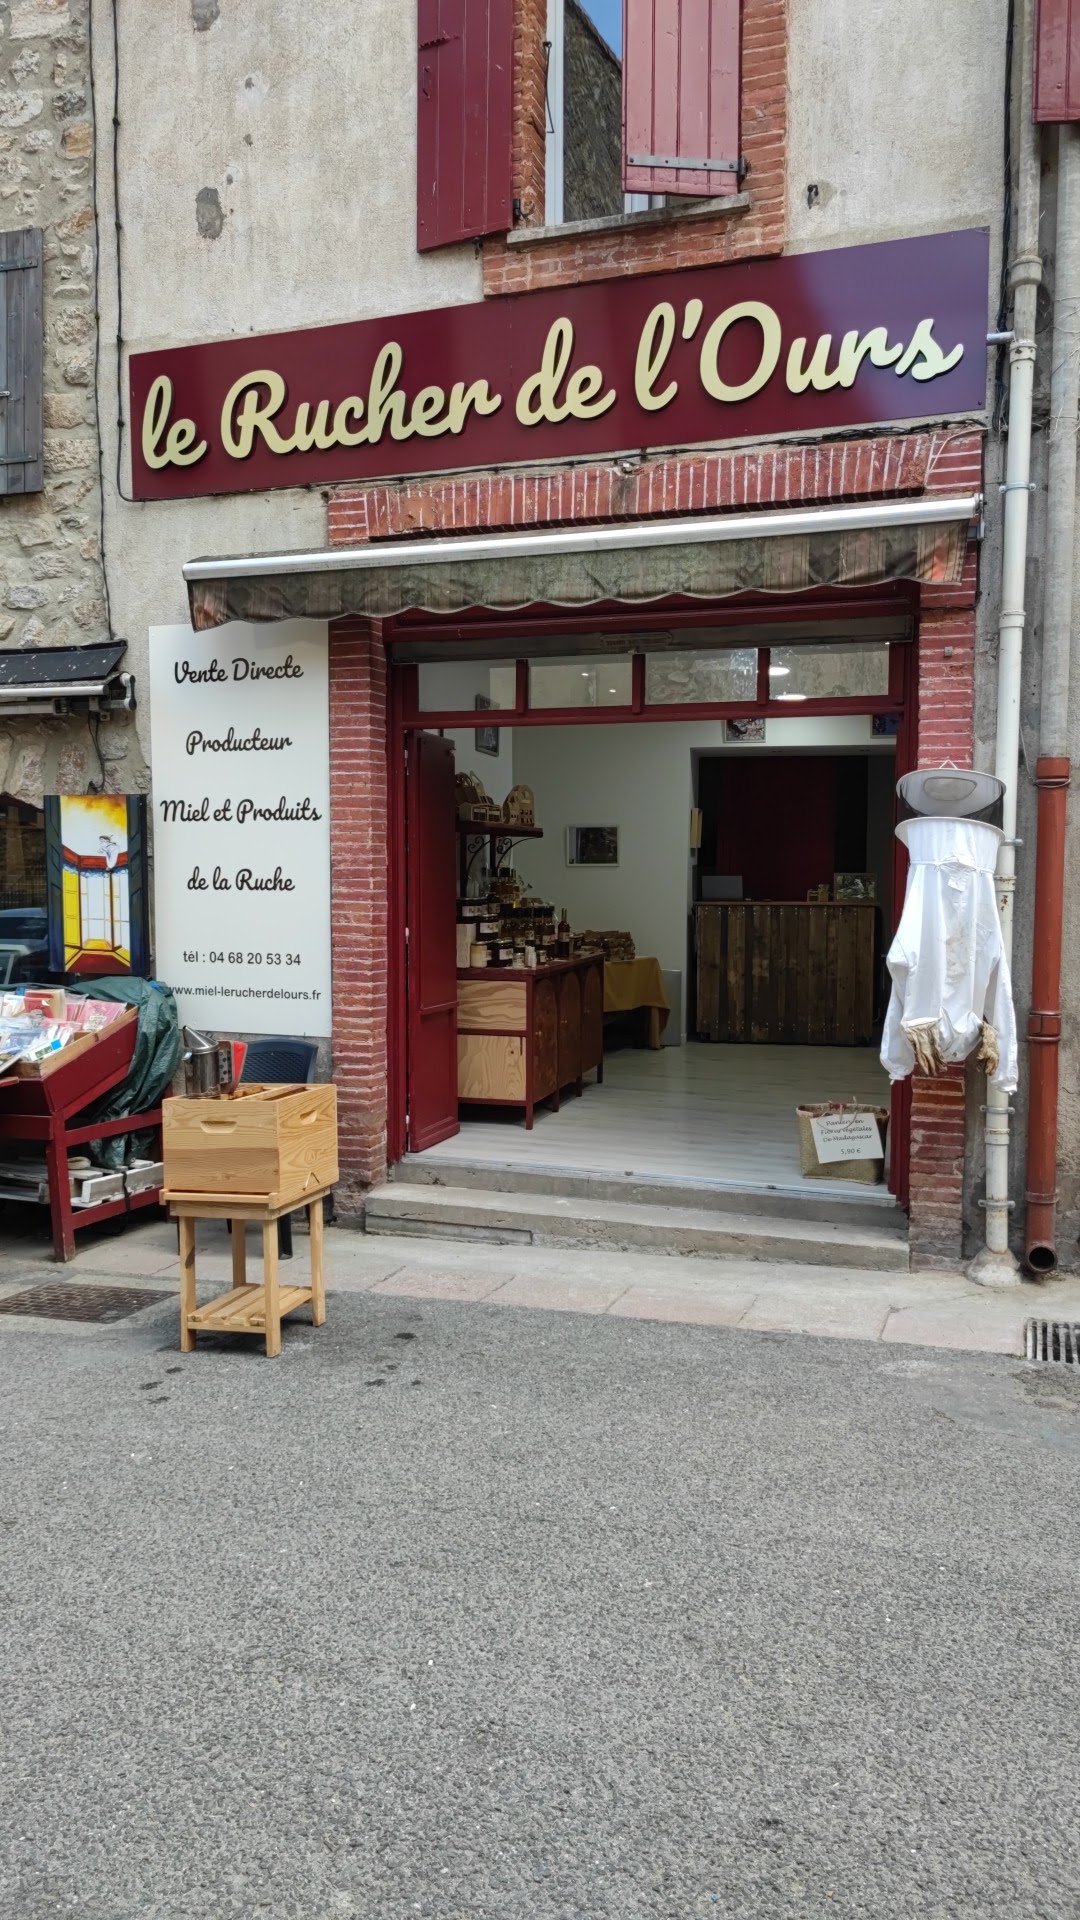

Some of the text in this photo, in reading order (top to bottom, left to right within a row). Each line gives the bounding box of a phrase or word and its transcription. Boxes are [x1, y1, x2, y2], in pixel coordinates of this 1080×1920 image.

[142, 298, 965, 469] le Rucher de l'Ours
[174, 655, 304, 684] Vente Directe
[186, 727, 293, 756] Producteur
[160, 796, 323, 824] Miel et Produits
[187, 865, 296, 892] de la Ruche
[182, 950, 199, 963] tél
[209, 951, 225, 963] 04
[228, 951, 244, 964] 68
[247, 952, 263, 965] 20
[266, 953, 282, 966] 53
[285, 953, 302, 966] 34
